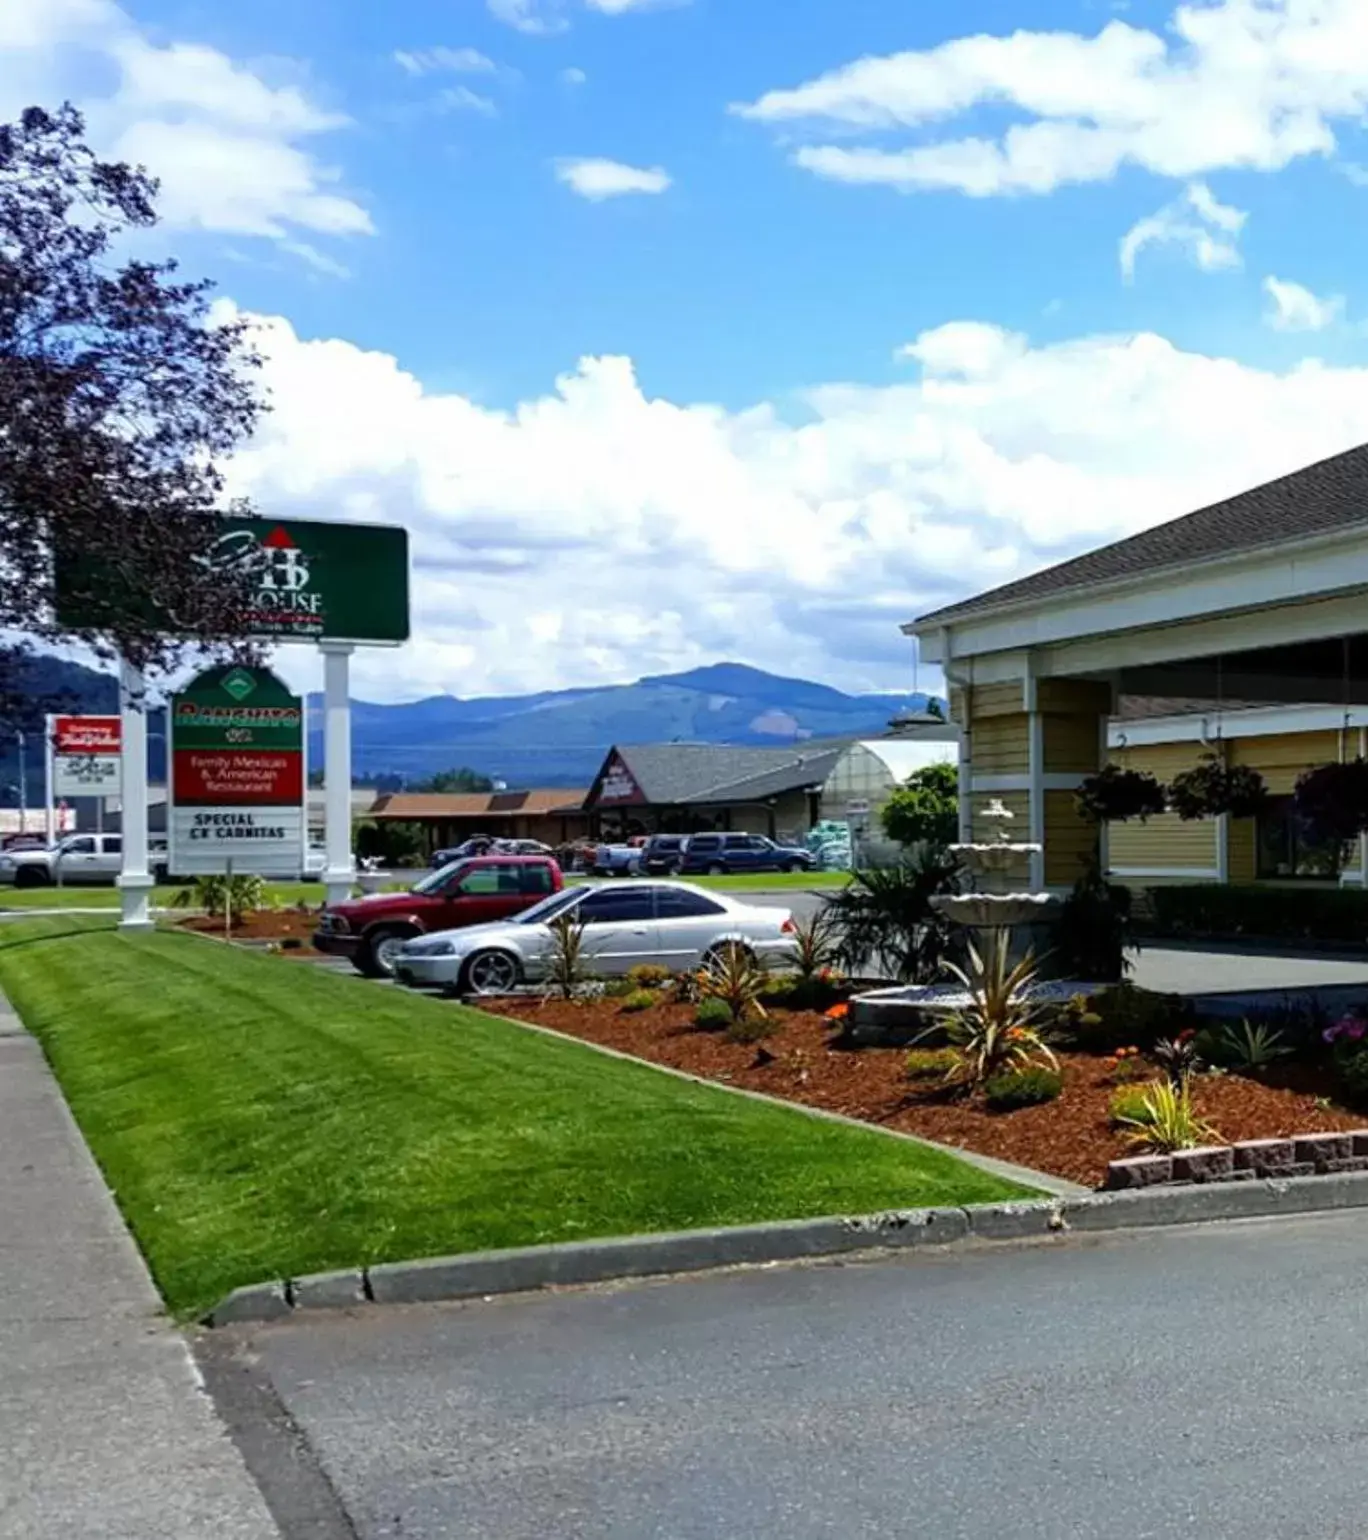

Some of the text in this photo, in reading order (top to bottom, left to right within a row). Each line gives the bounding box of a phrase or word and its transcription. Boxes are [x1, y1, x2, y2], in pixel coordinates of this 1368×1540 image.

[191, 756, 288, 769] Family Mexican
[217, 769, 278, 780] American
[206, 781, 273, 792] Restaurant
[194, 813, 254, 826] SPECIAL
[215, 827, 285, 839] CARNITAS
